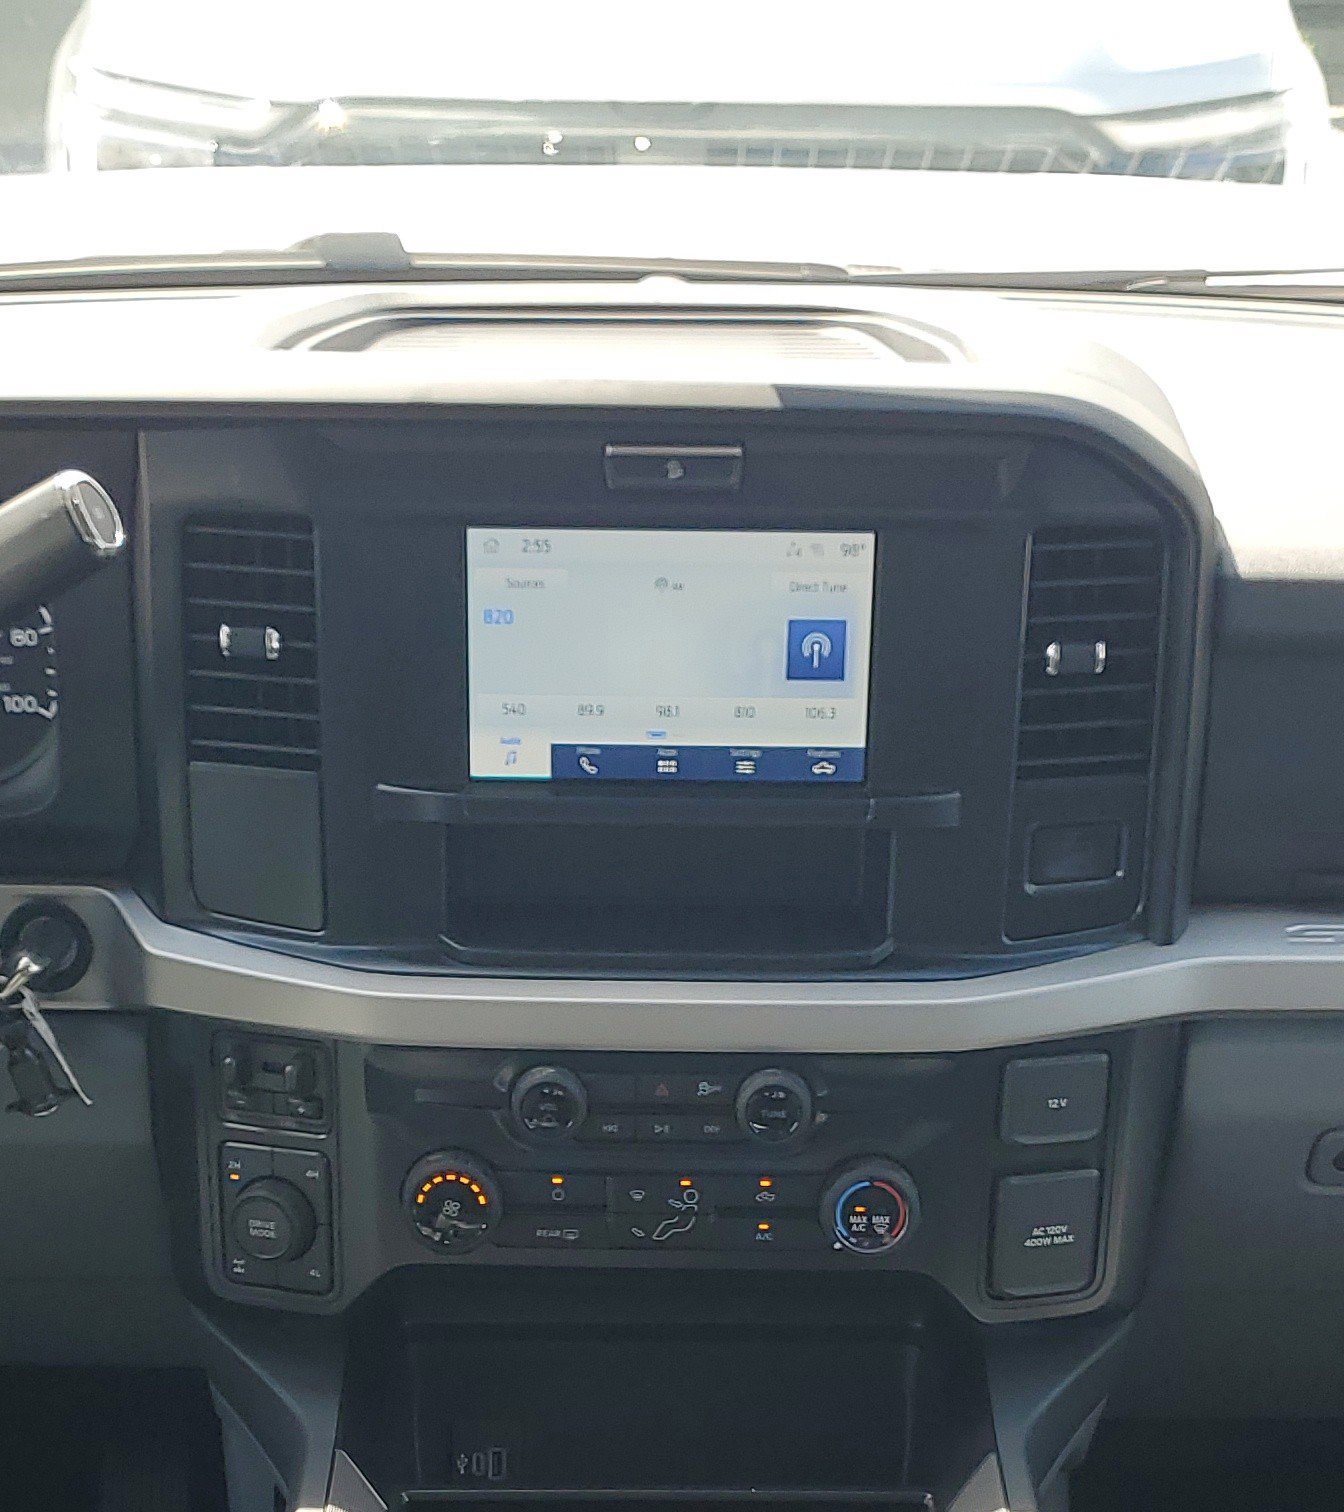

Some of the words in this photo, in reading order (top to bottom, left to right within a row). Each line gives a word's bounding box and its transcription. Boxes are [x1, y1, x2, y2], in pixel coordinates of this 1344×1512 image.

[2, 695, 38, 713] 100
[849, 1215, 868, 1224] MAX
[871, 1215, 891, 1224] MAX
[851, 1223, 867, 1232] A/C
